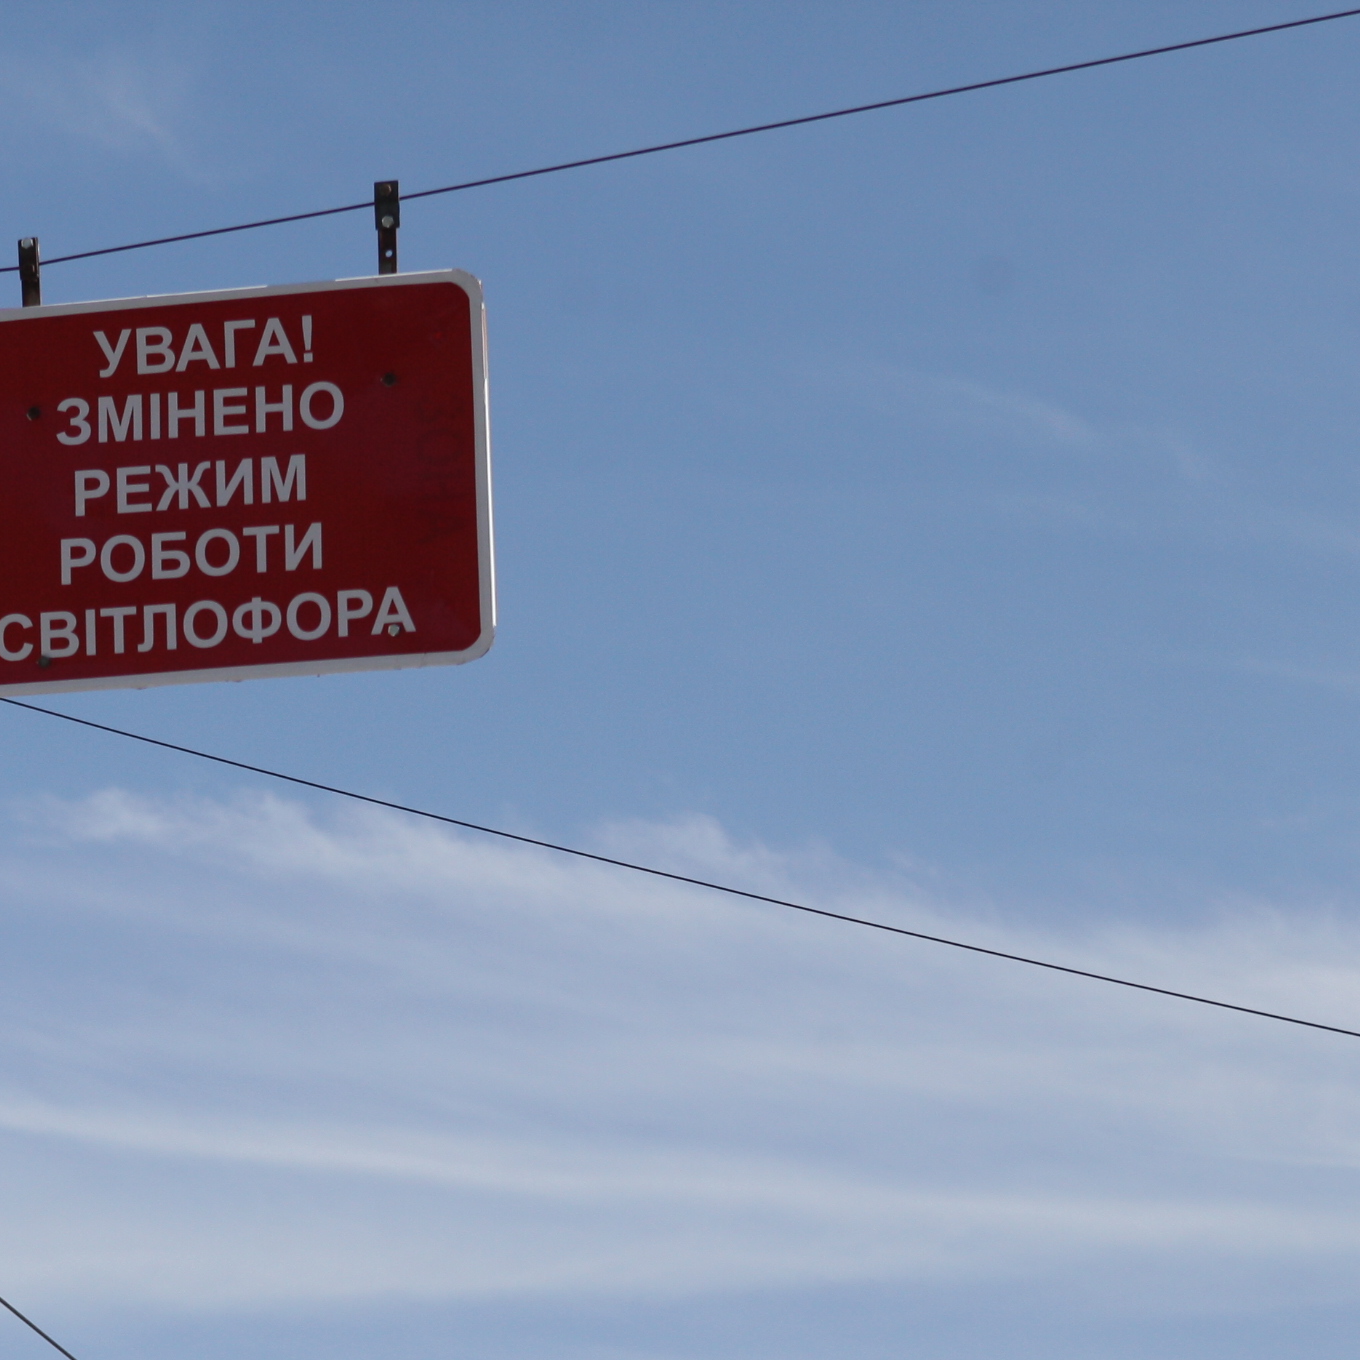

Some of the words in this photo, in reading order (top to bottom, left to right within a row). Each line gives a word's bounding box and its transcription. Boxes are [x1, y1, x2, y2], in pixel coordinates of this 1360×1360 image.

[93, 315, 313, 378] УВАГА!
[56, 381, 344, 446] ЗМІНЕНО
[74, 454, 307, 517] РЕЖИМ
[60, 522, 323, 586] РОБОТИ
